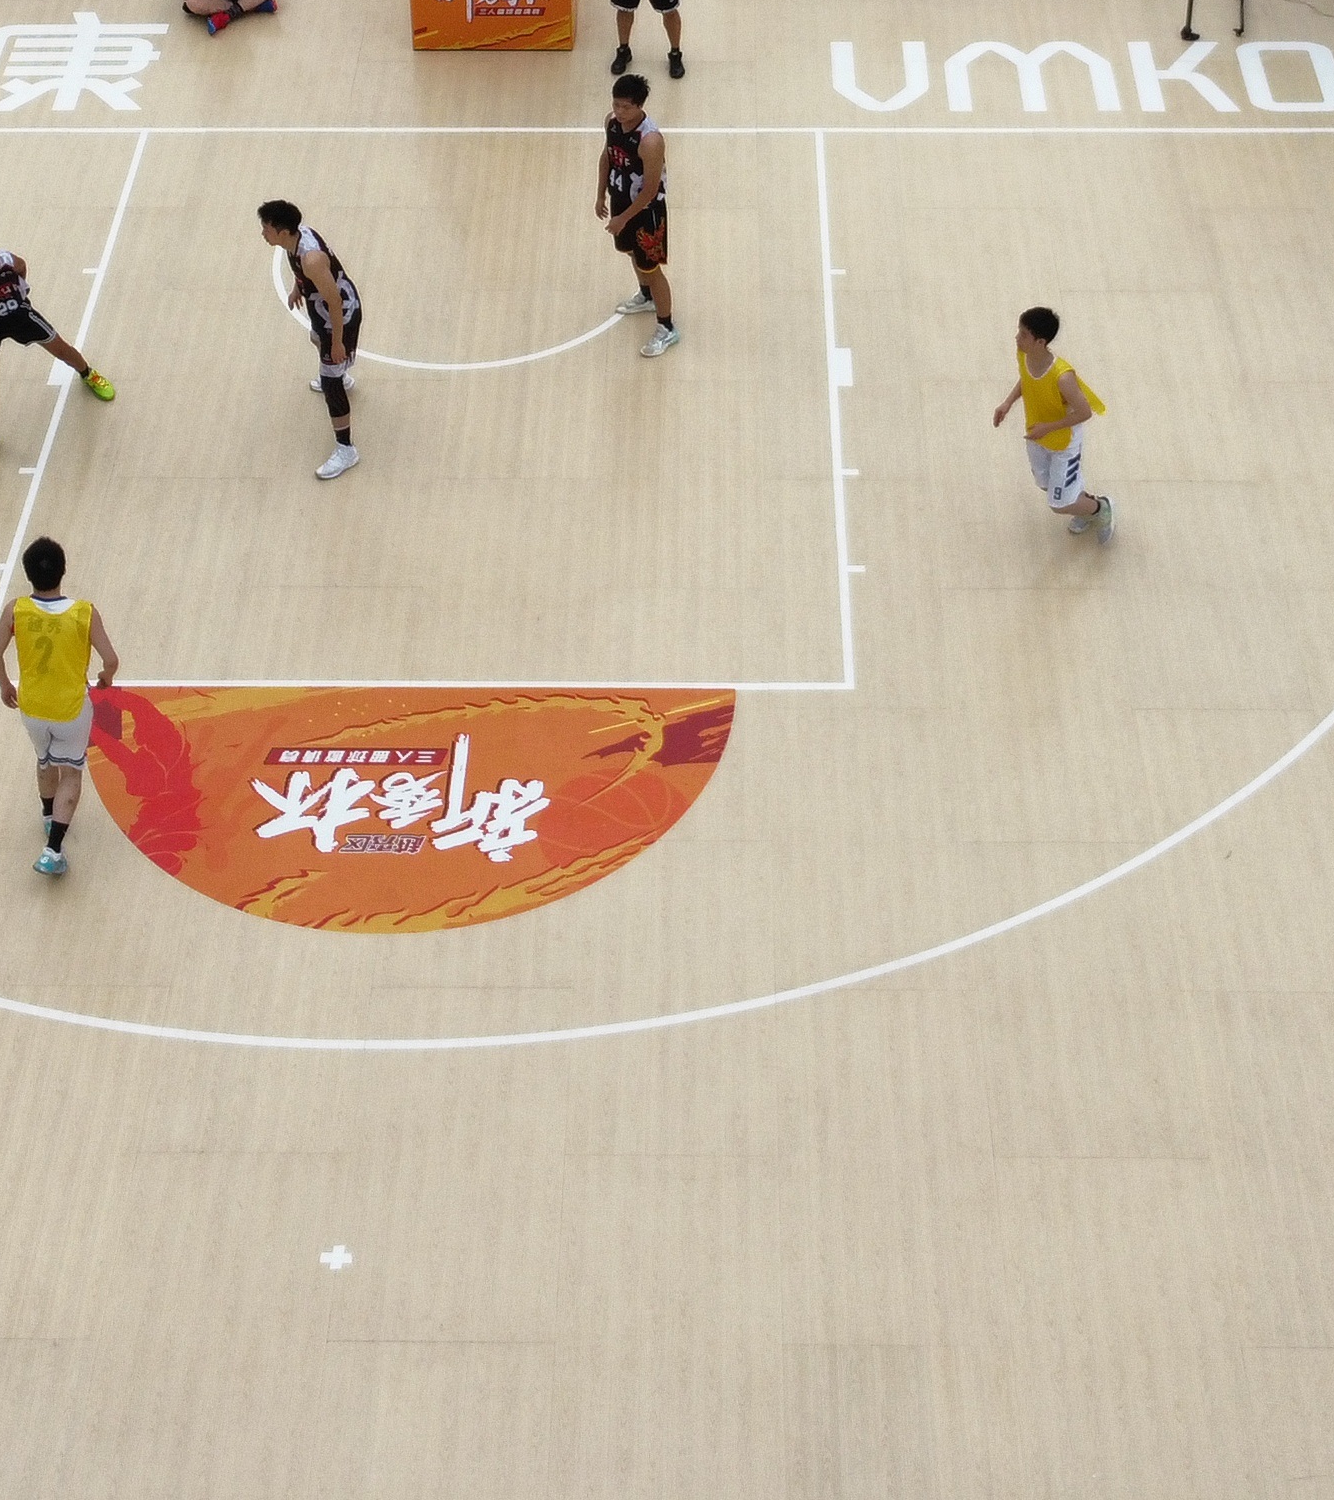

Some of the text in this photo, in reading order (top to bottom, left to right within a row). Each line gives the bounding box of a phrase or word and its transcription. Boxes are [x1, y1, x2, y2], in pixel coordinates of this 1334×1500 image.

[609, 169, 624, 193] 44
[277, 748, 438, 764] 三人篮球邀请赛
[249, 734, 552, 864] 新秀杯
[338, 833, 426, 855] 越秀区
